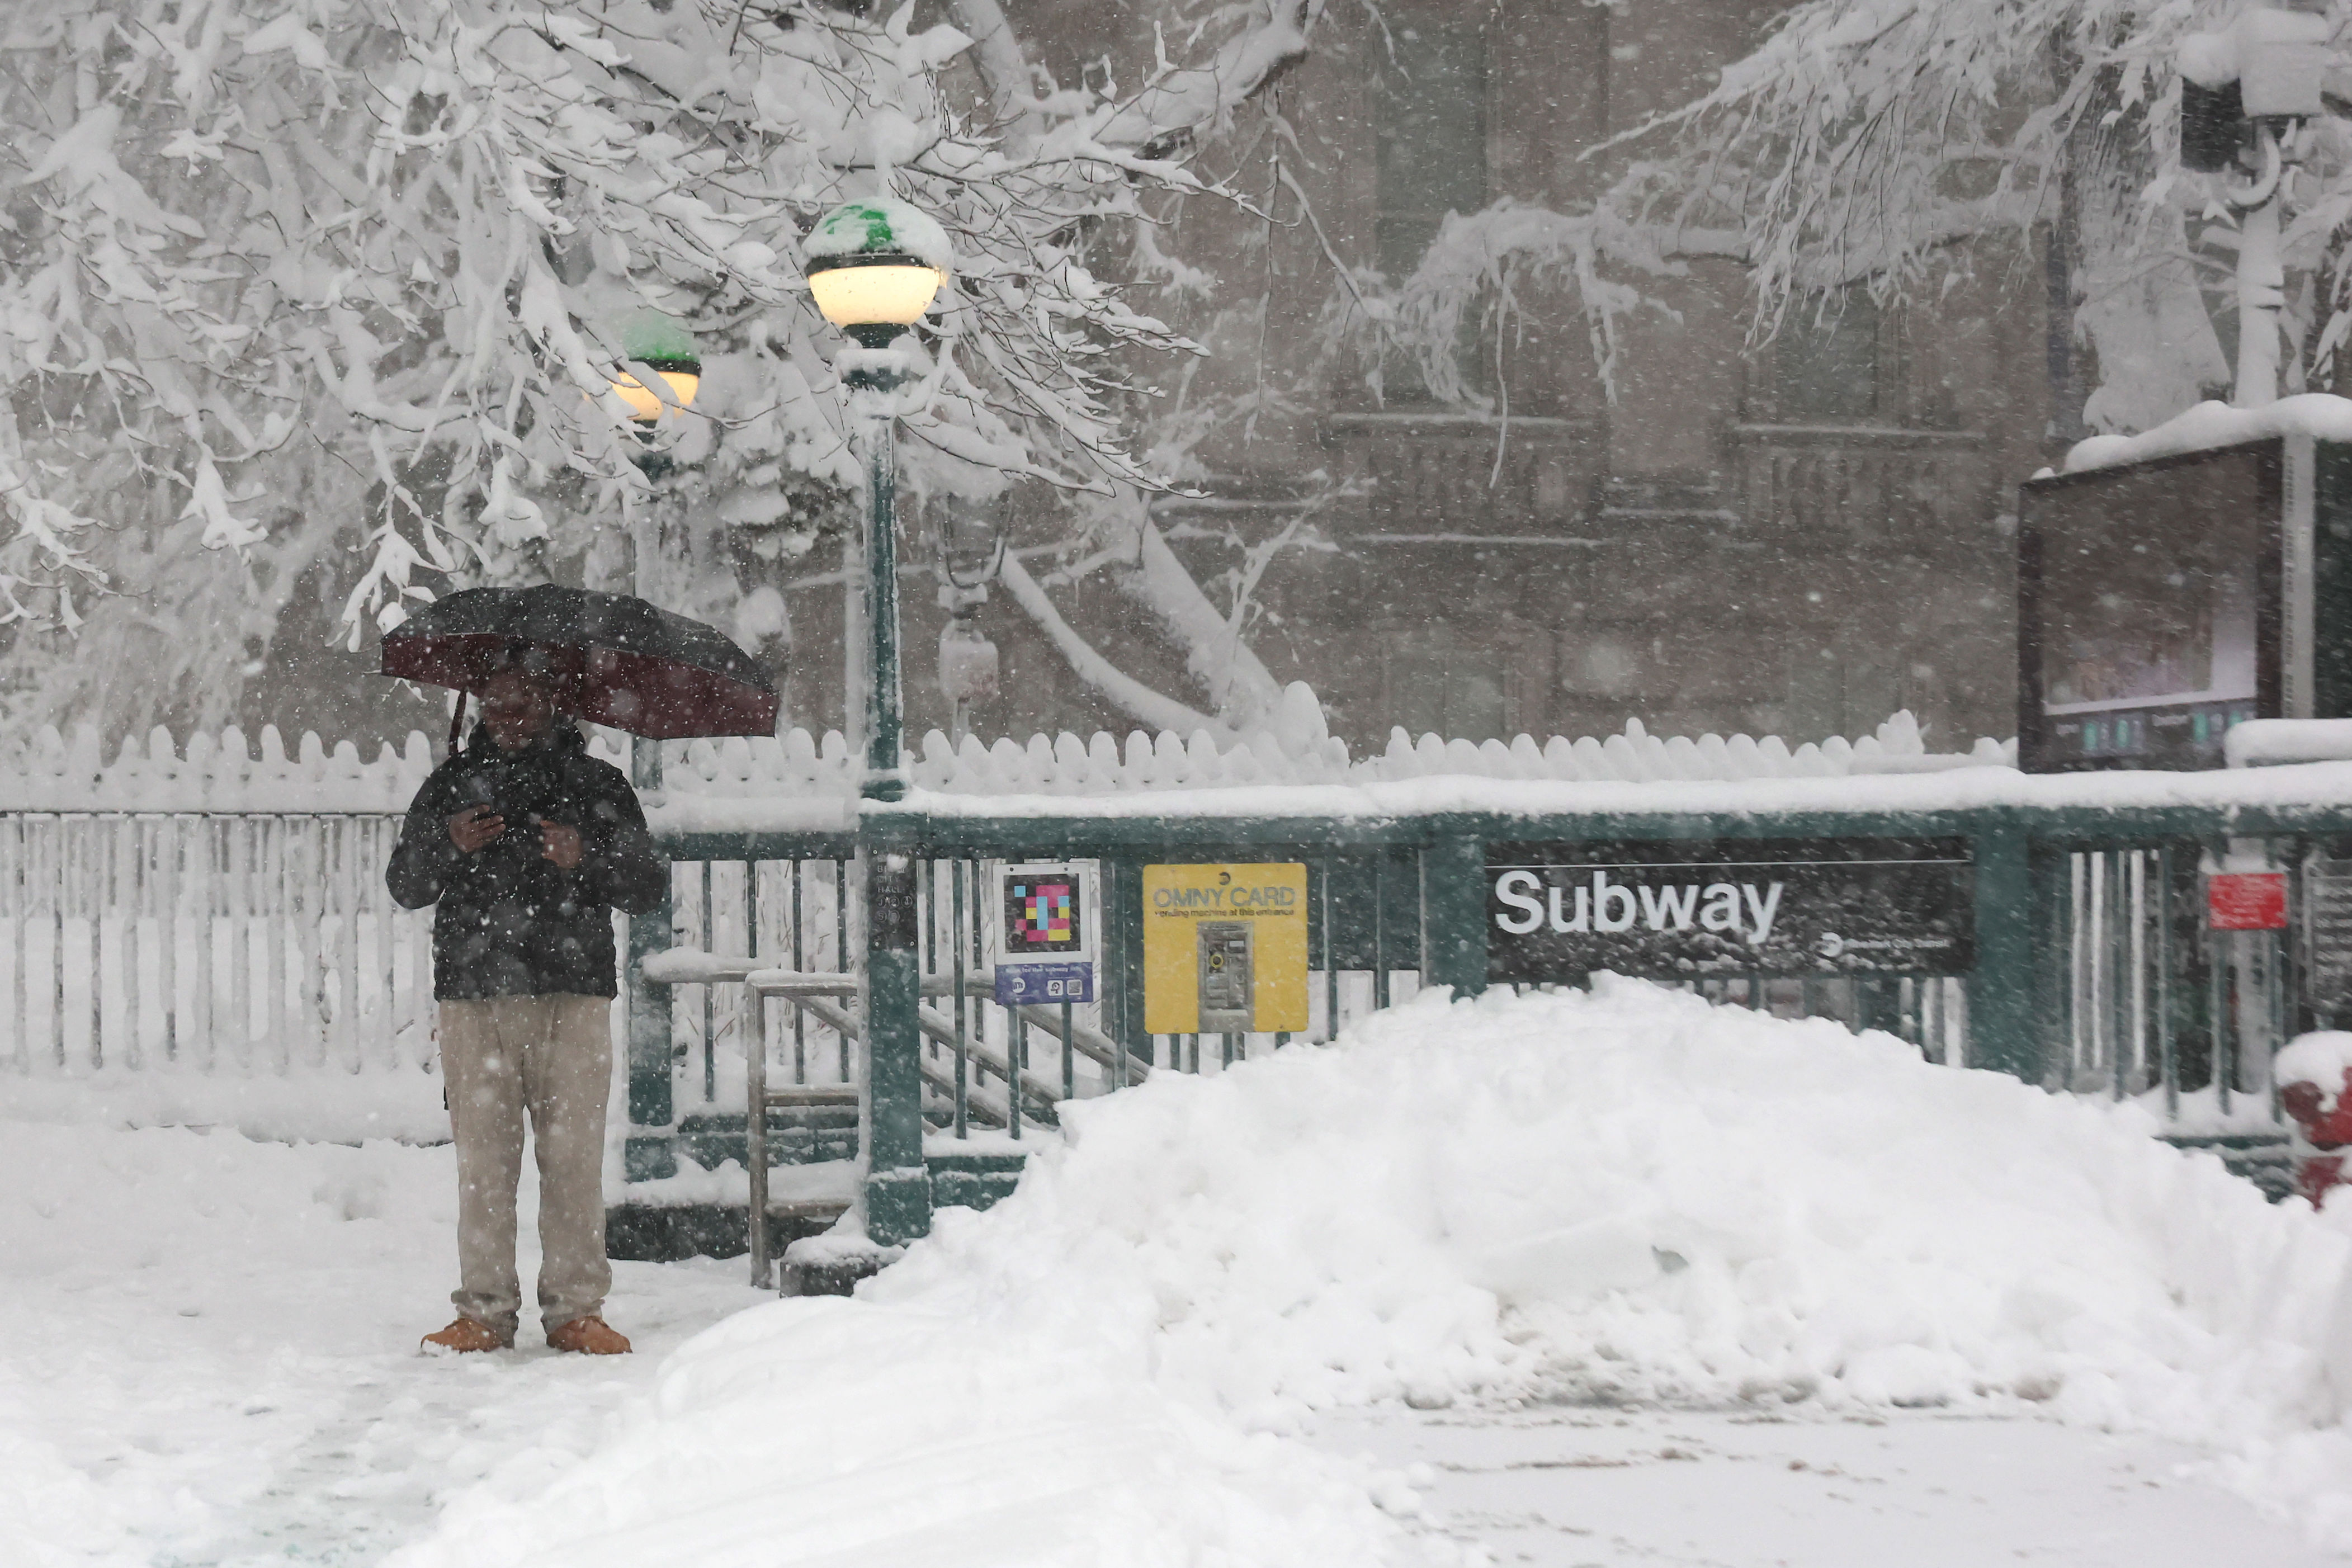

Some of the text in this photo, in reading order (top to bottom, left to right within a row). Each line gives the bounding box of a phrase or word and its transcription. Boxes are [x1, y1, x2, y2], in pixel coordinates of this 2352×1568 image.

[1153, 887, 1295, 907] OMNY CARD
[1495, 870, 1783, 944] Subway
[1155, 909, 1189, 918] vending
